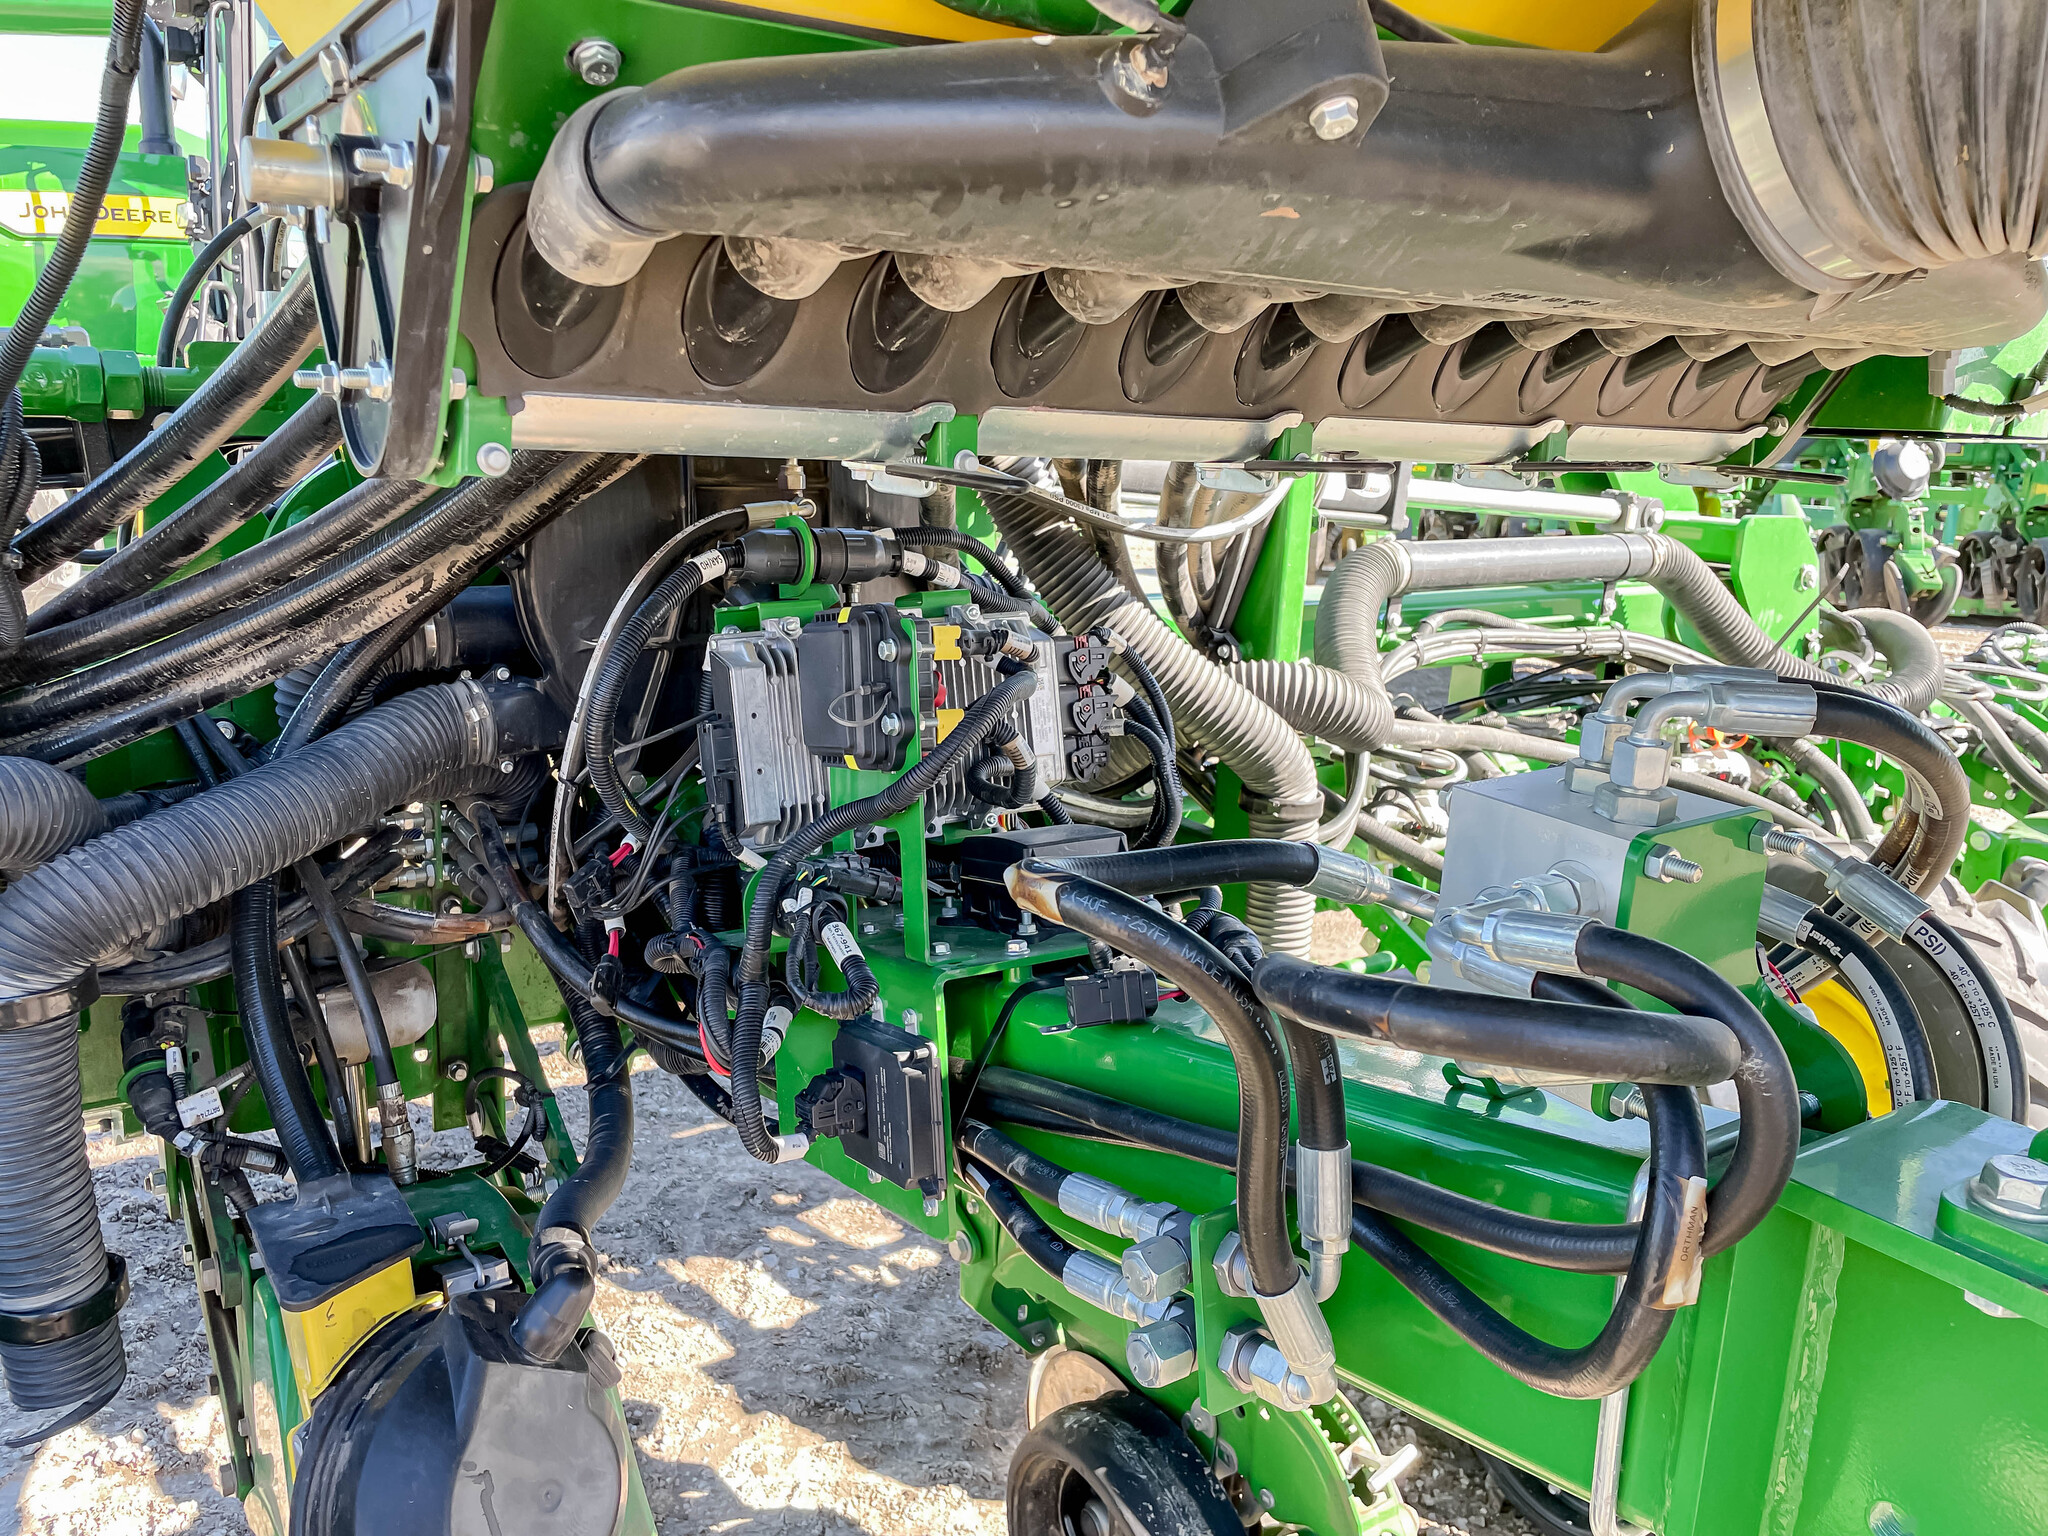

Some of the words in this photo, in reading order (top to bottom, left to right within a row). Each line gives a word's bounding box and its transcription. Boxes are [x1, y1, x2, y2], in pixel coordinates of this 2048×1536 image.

[19, 202, 69, 220] JOH
[98, 206, 173, 224] DEERE
[832, 924, 852, 954] 367-941
[1809, 929, 1844, 960] Parker
[1914, 926, 1947, 957] PSI)
[1121, 913, 1170, 947] +257F)
[1180, 944, 1222, 983] MADE
[1234, 990, 1255, 1017] USA
[1868, 985, 1878, 998] USA
[1881, 1006, 1891, 1026] MADE
[1988, 1046, 1997, 1066] MADE
[1680, 1206, 1699, 1262] ORTHMAN
